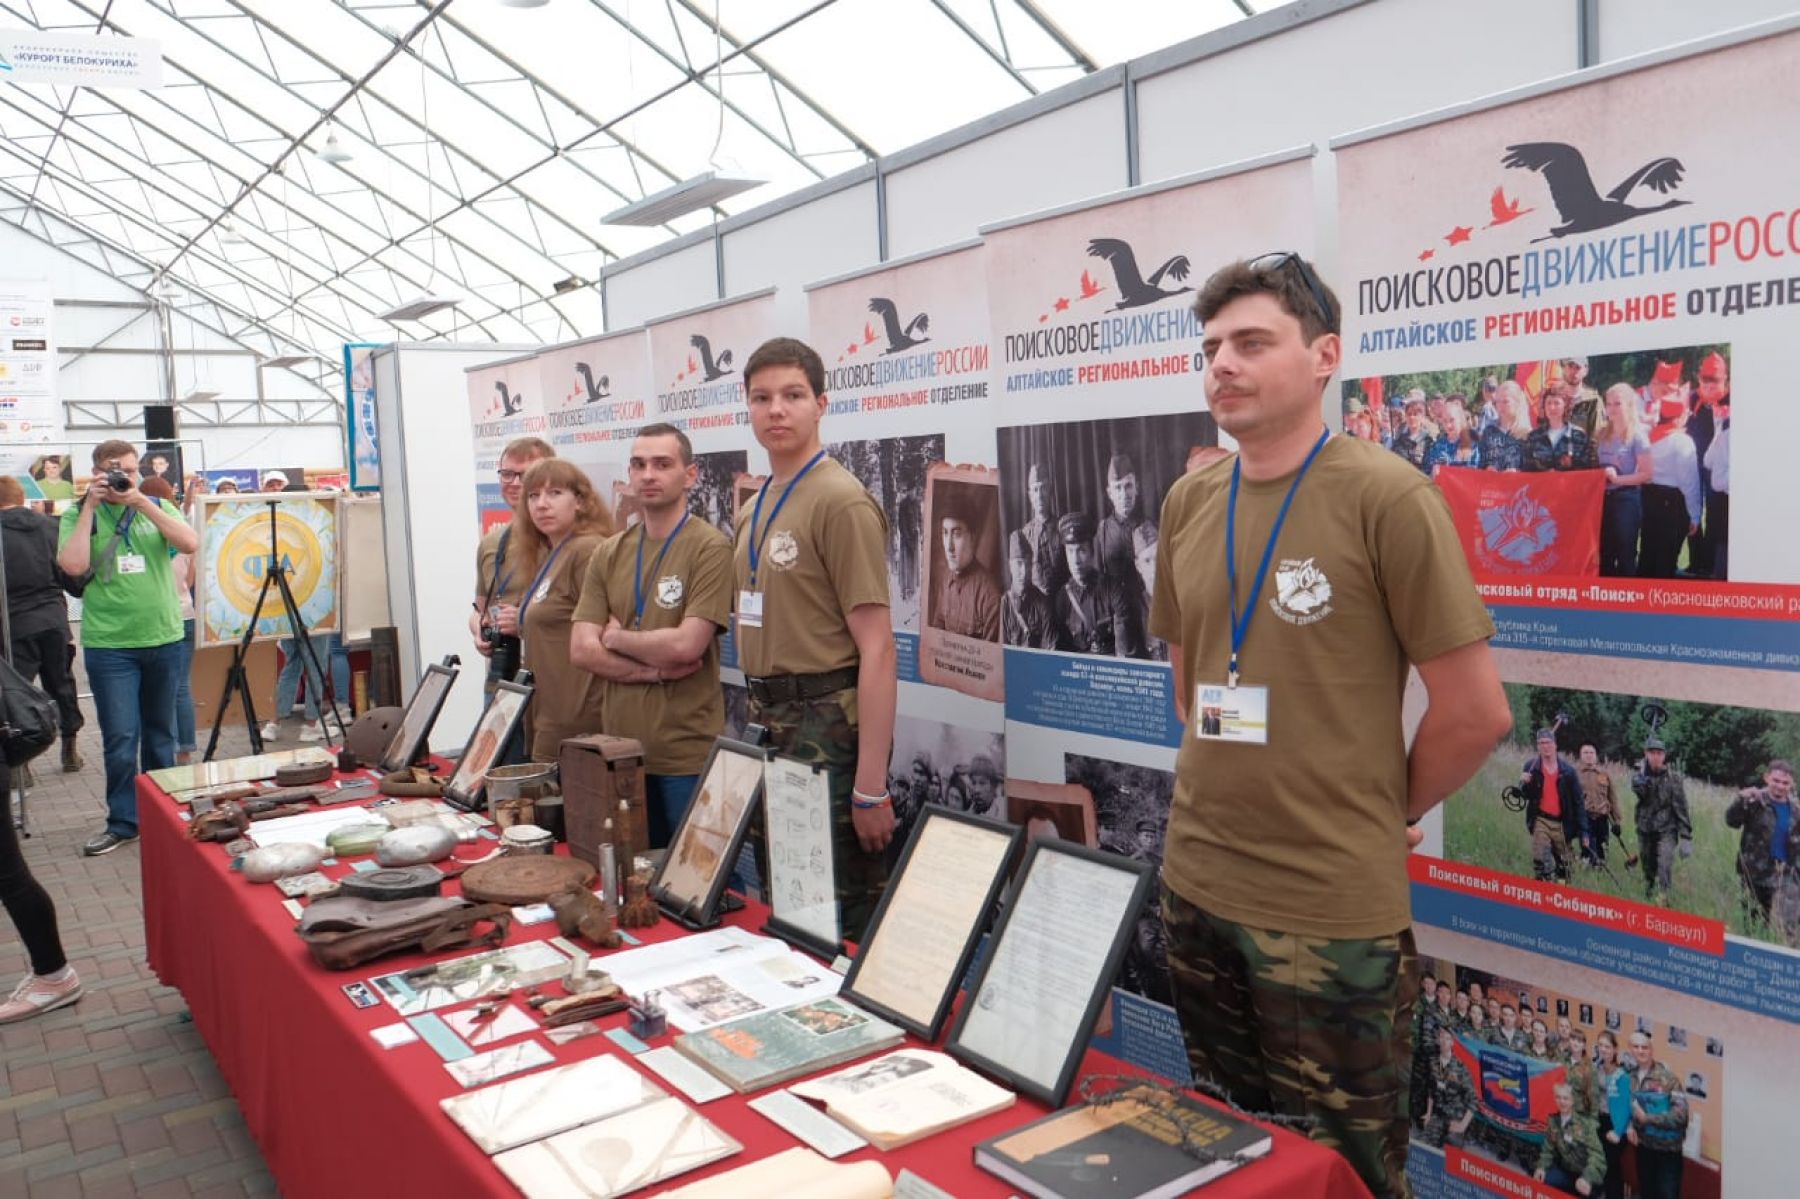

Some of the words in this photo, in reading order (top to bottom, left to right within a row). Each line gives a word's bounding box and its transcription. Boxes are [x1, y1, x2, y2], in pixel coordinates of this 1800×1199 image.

[1359, 317, 1477, 354] АЛТАЙСКОЕ
[1484, 291, 1677, 340] РЕГИОНАЛЬНОЕ
[1006, 368, 1073, 392] АЛТАЙСКОЕ
[1078, 354, 1189, 384] РЕГИОНАЛЬНОЕ
[861, 389, 929, 412] РЕГИОНАЛЬНОЕ
[931, 382, 988, 405] ОТДЕЛЕНИЕ
[1537, 586, 1577, 602] отряд
[1582, 585, 1645, 603] «Поиск»
[1648, 588, 1784, 610] (Краснощековский
[1429, 865, 1499, 893] Поисковый
[1503, 884, 1542, 904] отряд
[1546, 893, 1623, 921] «Сибиряк»
[1626, 909, 1641, 929] (г.
[1645, 919, 1708, 945] Барнаул)
[1460, 1158, 1532, 1199] Поисковый
